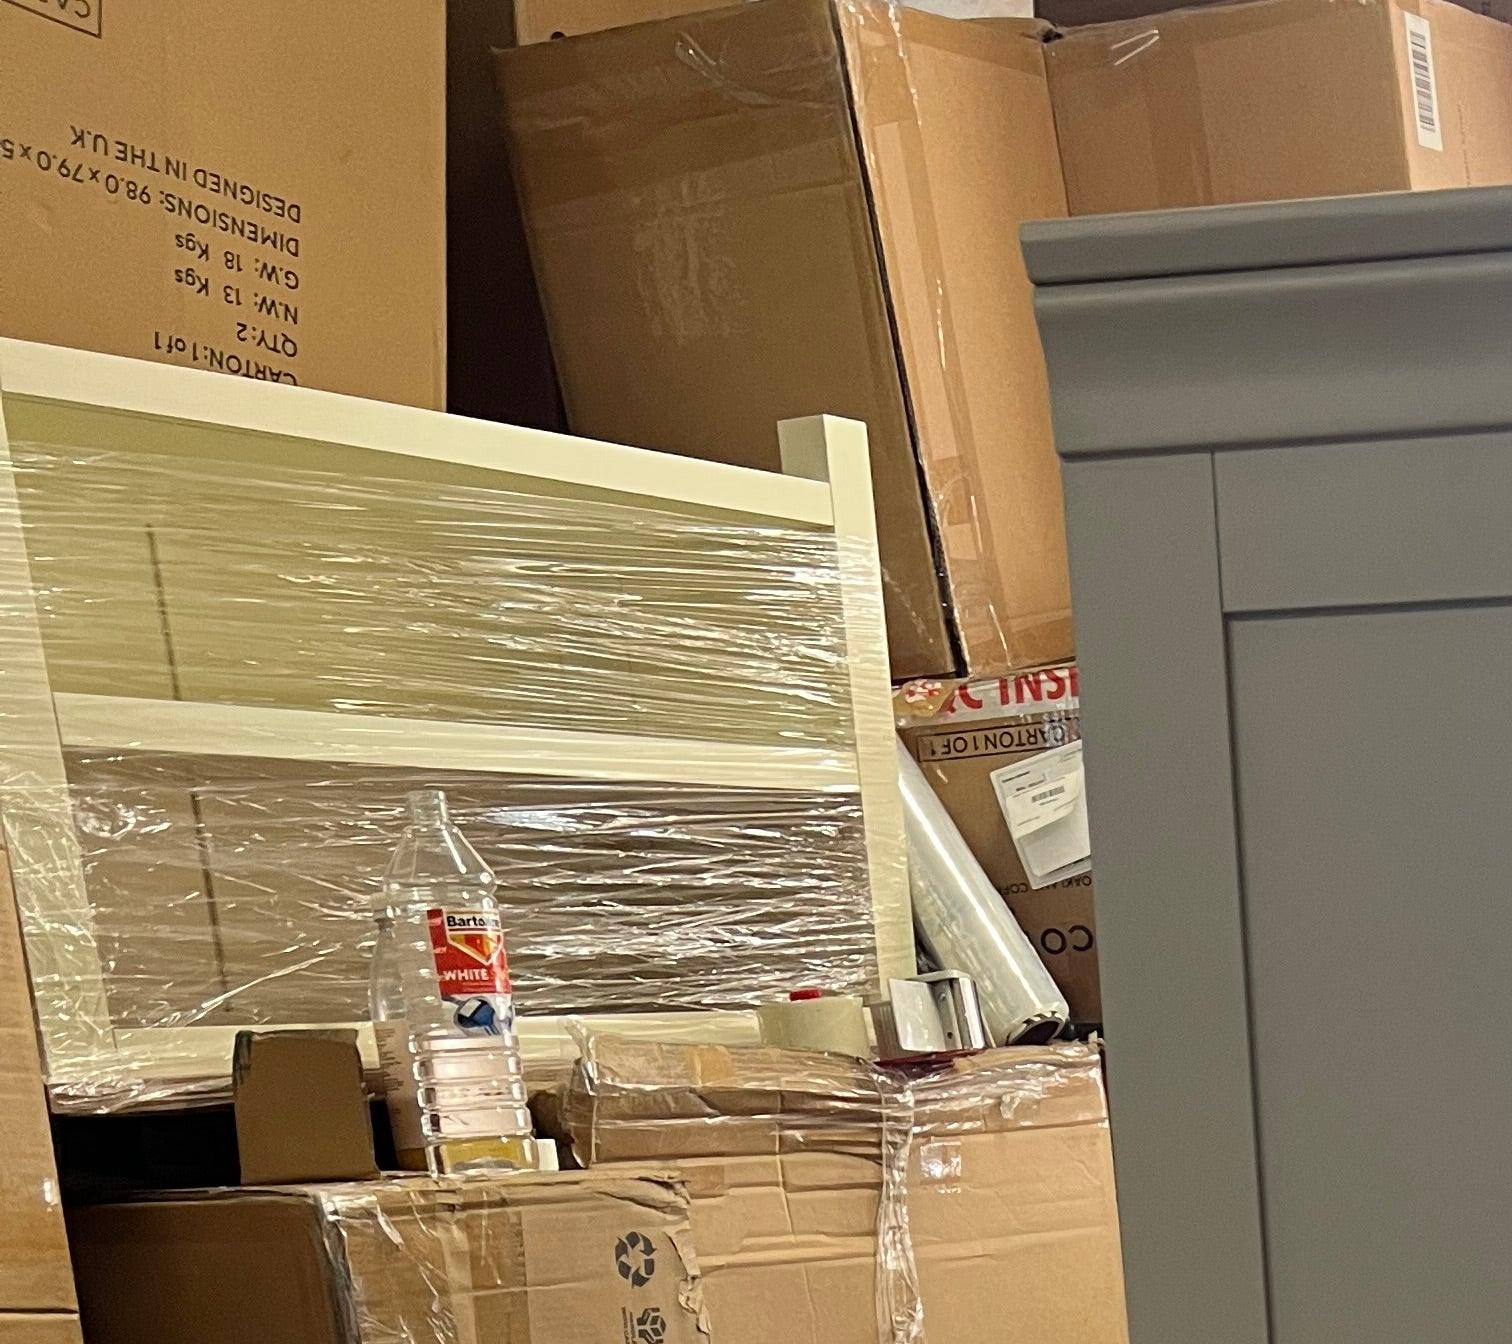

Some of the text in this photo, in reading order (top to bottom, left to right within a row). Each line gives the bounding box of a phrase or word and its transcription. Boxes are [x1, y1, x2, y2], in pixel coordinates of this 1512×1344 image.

[36, 150, 84, 183] 79.0
[70, 125, 300, 224] DESIGNED IN THE U.K
[105, 173, 152, 205] 98.0
[159, 190, 299, 258] DIMENSIONS:
[175, 232, 299, 290] G.W: 18 Kgs
[175, 268, 298, 325] N.W: 13 Kgs
[941, 736, 968, 756] OF
[443, 968, 490, 981] WHITE
